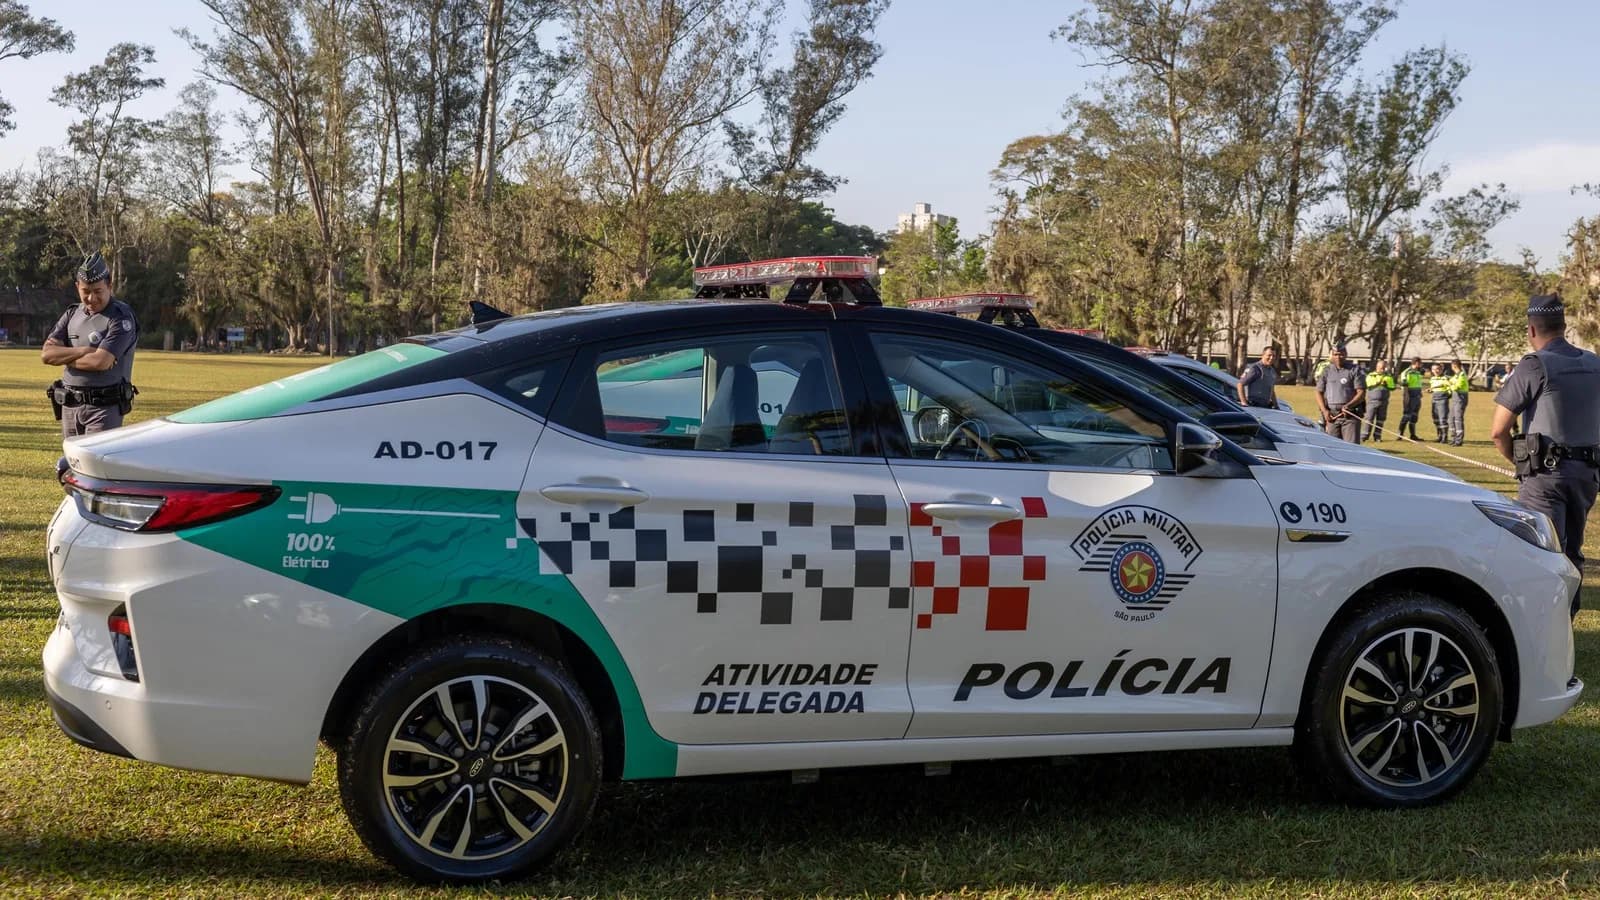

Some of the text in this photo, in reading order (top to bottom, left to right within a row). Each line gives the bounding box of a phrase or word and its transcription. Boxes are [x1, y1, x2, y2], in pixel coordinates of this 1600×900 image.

[374, 440, 498, 460] AD-017
[1306, 502, 1347, 524] 190
[287, 533, 335, 552] 100%
[1079, 509, 1194, 558] POLÍCIA MILITAR
[282, 555, 330, 569] Elétrico
[1113, 610, 1156, 622] SÃO PAULO
[702, 663, 879, 686] ATIVIDADE
[952, 649, 1232, 702] POLÍCIA
[693, 691, 865, 715] DELEGADA
